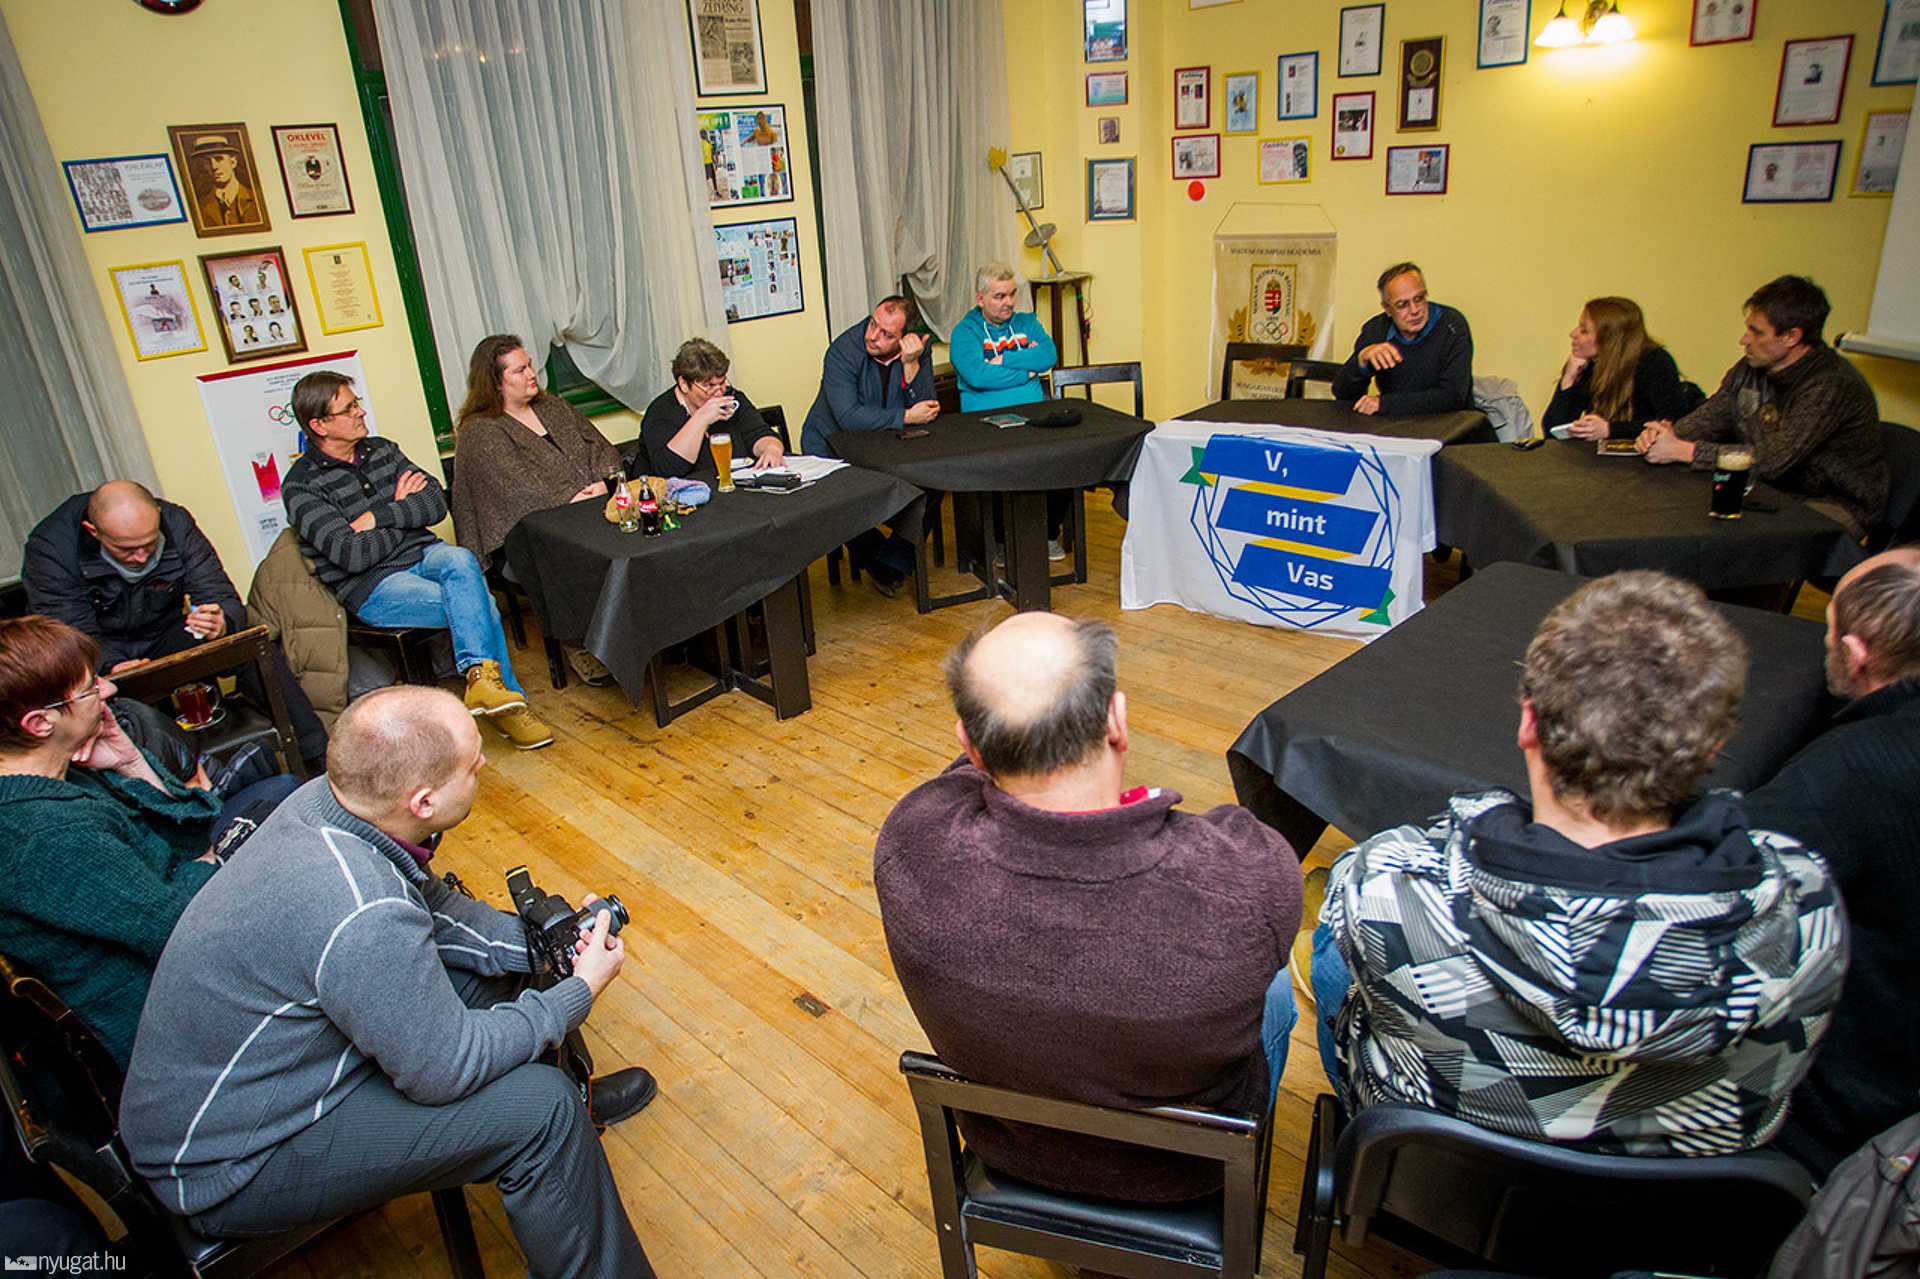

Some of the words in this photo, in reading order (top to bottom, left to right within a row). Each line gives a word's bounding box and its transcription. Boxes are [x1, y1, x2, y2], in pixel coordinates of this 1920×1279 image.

[1264, 449, 1288, 478] V,
[1266, 508, 1327, 535] mint
[1287, 561, 1334, 591] Vas
